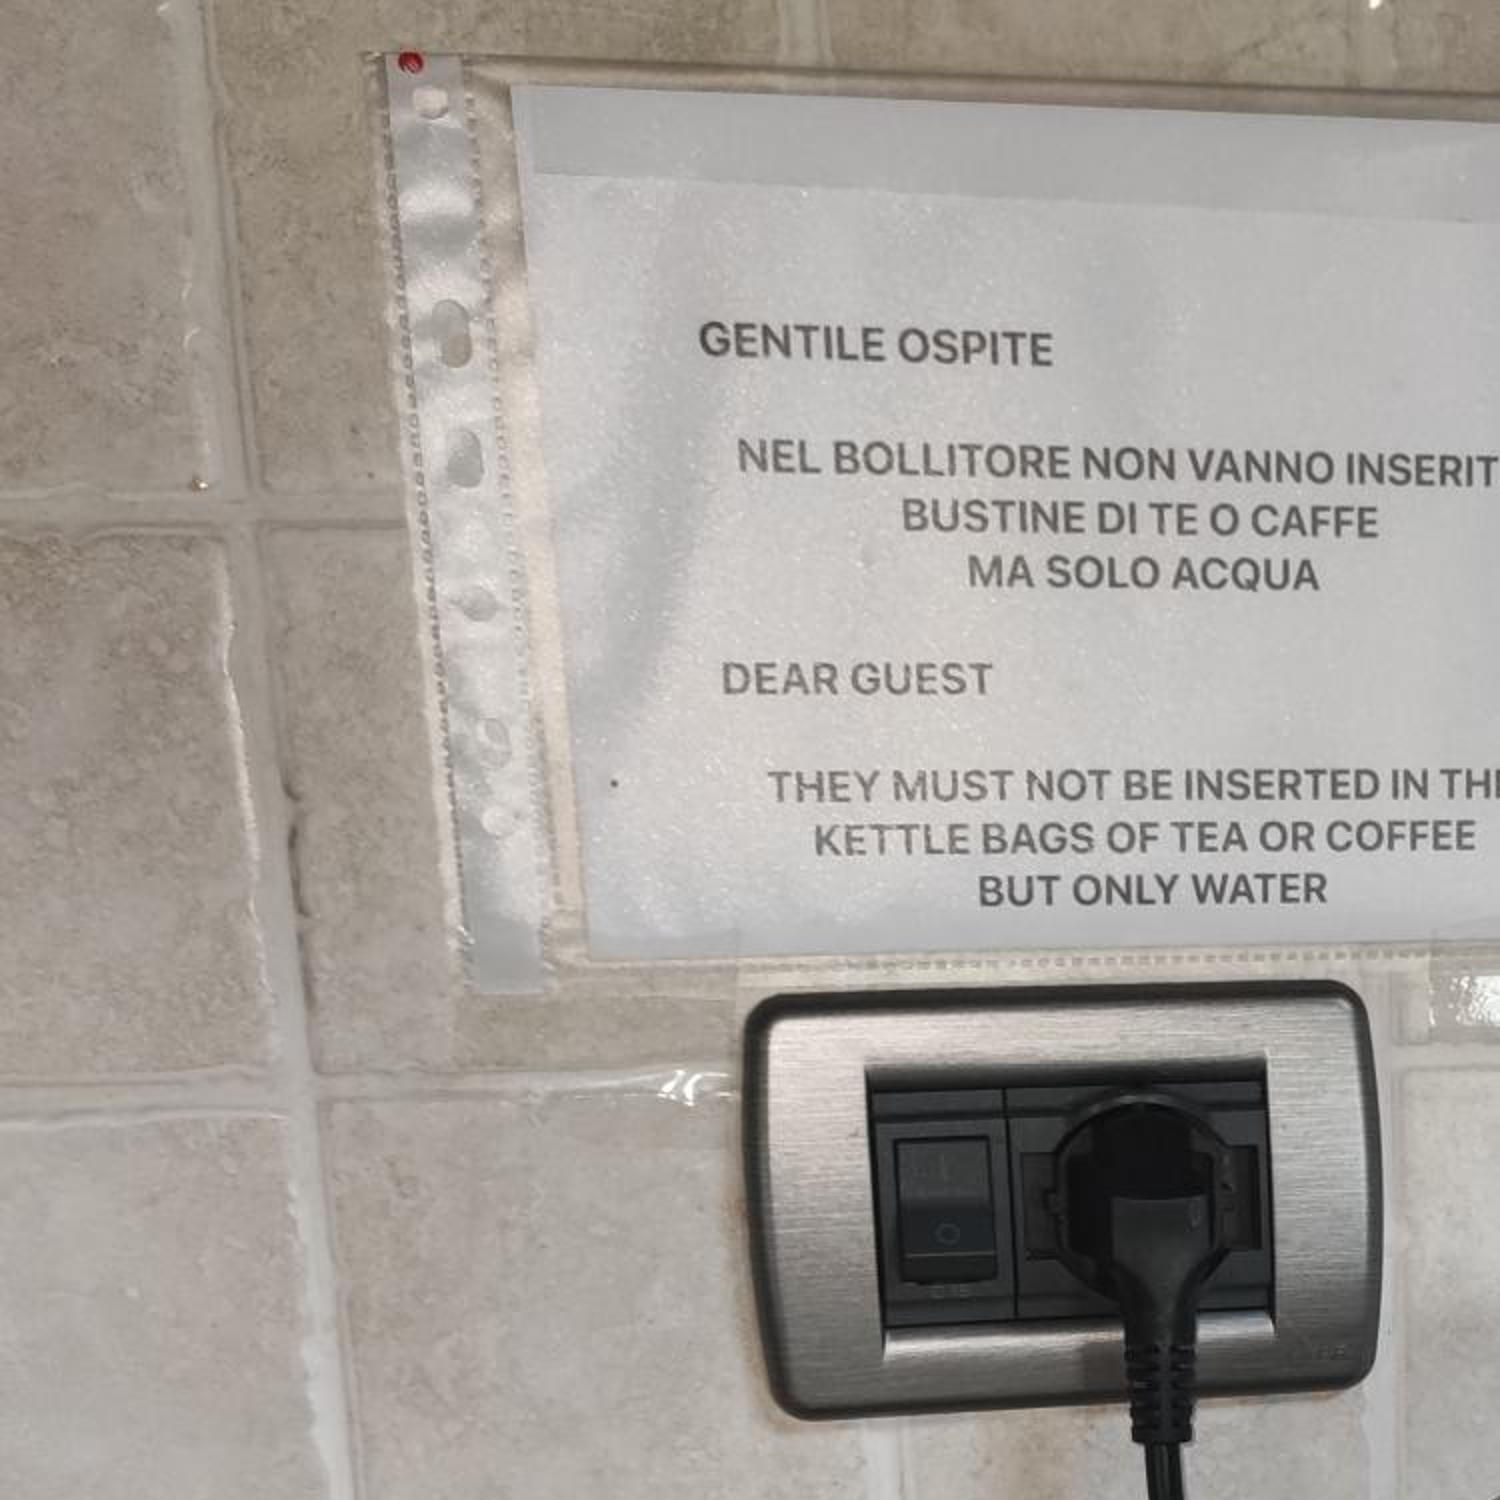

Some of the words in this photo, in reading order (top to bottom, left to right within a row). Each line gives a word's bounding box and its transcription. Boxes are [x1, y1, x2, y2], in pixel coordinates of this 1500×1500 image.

[698, 320, 886, 363] GENTILE
[897, 327, 1053, 367] OSPITE
[737, 437, 822, 475] NEL
[833, 440, 1071, 480] BOLLITORE
[1082, 446, 1176, 481] NON
[1187, 448, 1335, 485] VANNO
[902, 498, 1086, 535] BUSTINE
[1097, 501, 1137, 535] DI
[1147, 501, 1199, 537] TE
[1209, 502, 1240, 537] O
[1251, 503, 1379, 539] CAFFE
[968, 554, 1036, 589] MA
[1046, 554, 1161, 589] SOLO
[1172, 556, 1320, 593] ACQUA
[722, 661, 839, 696] DEAR
[850, 661, 994, 696] GUEST
[767, 769, 881, 804] THEY
[892, 769, 1015, 803] MUST
[1026, 768, 1112, 802] NOT
[1123, 768, 1173, 801] BE
[1185, 768, 1381, 801] INSERTED
[1391, 768, 1429, 801] IN
[814, 823, 971, 857] KETTLE
[982, 821, 1095, 855] BAGS
[1106, 821, 1160, 855] OF
[1169, 821, 1249, 853] TEA
[1259, 820, 1315, 853] OR
[1325, 819, 1476, 853] COFFEE
[979, 874, 1061, 907] BUT
[1072, 873, 1180, 907] ONLY
[1191, 872, 1327, 905] WATER
